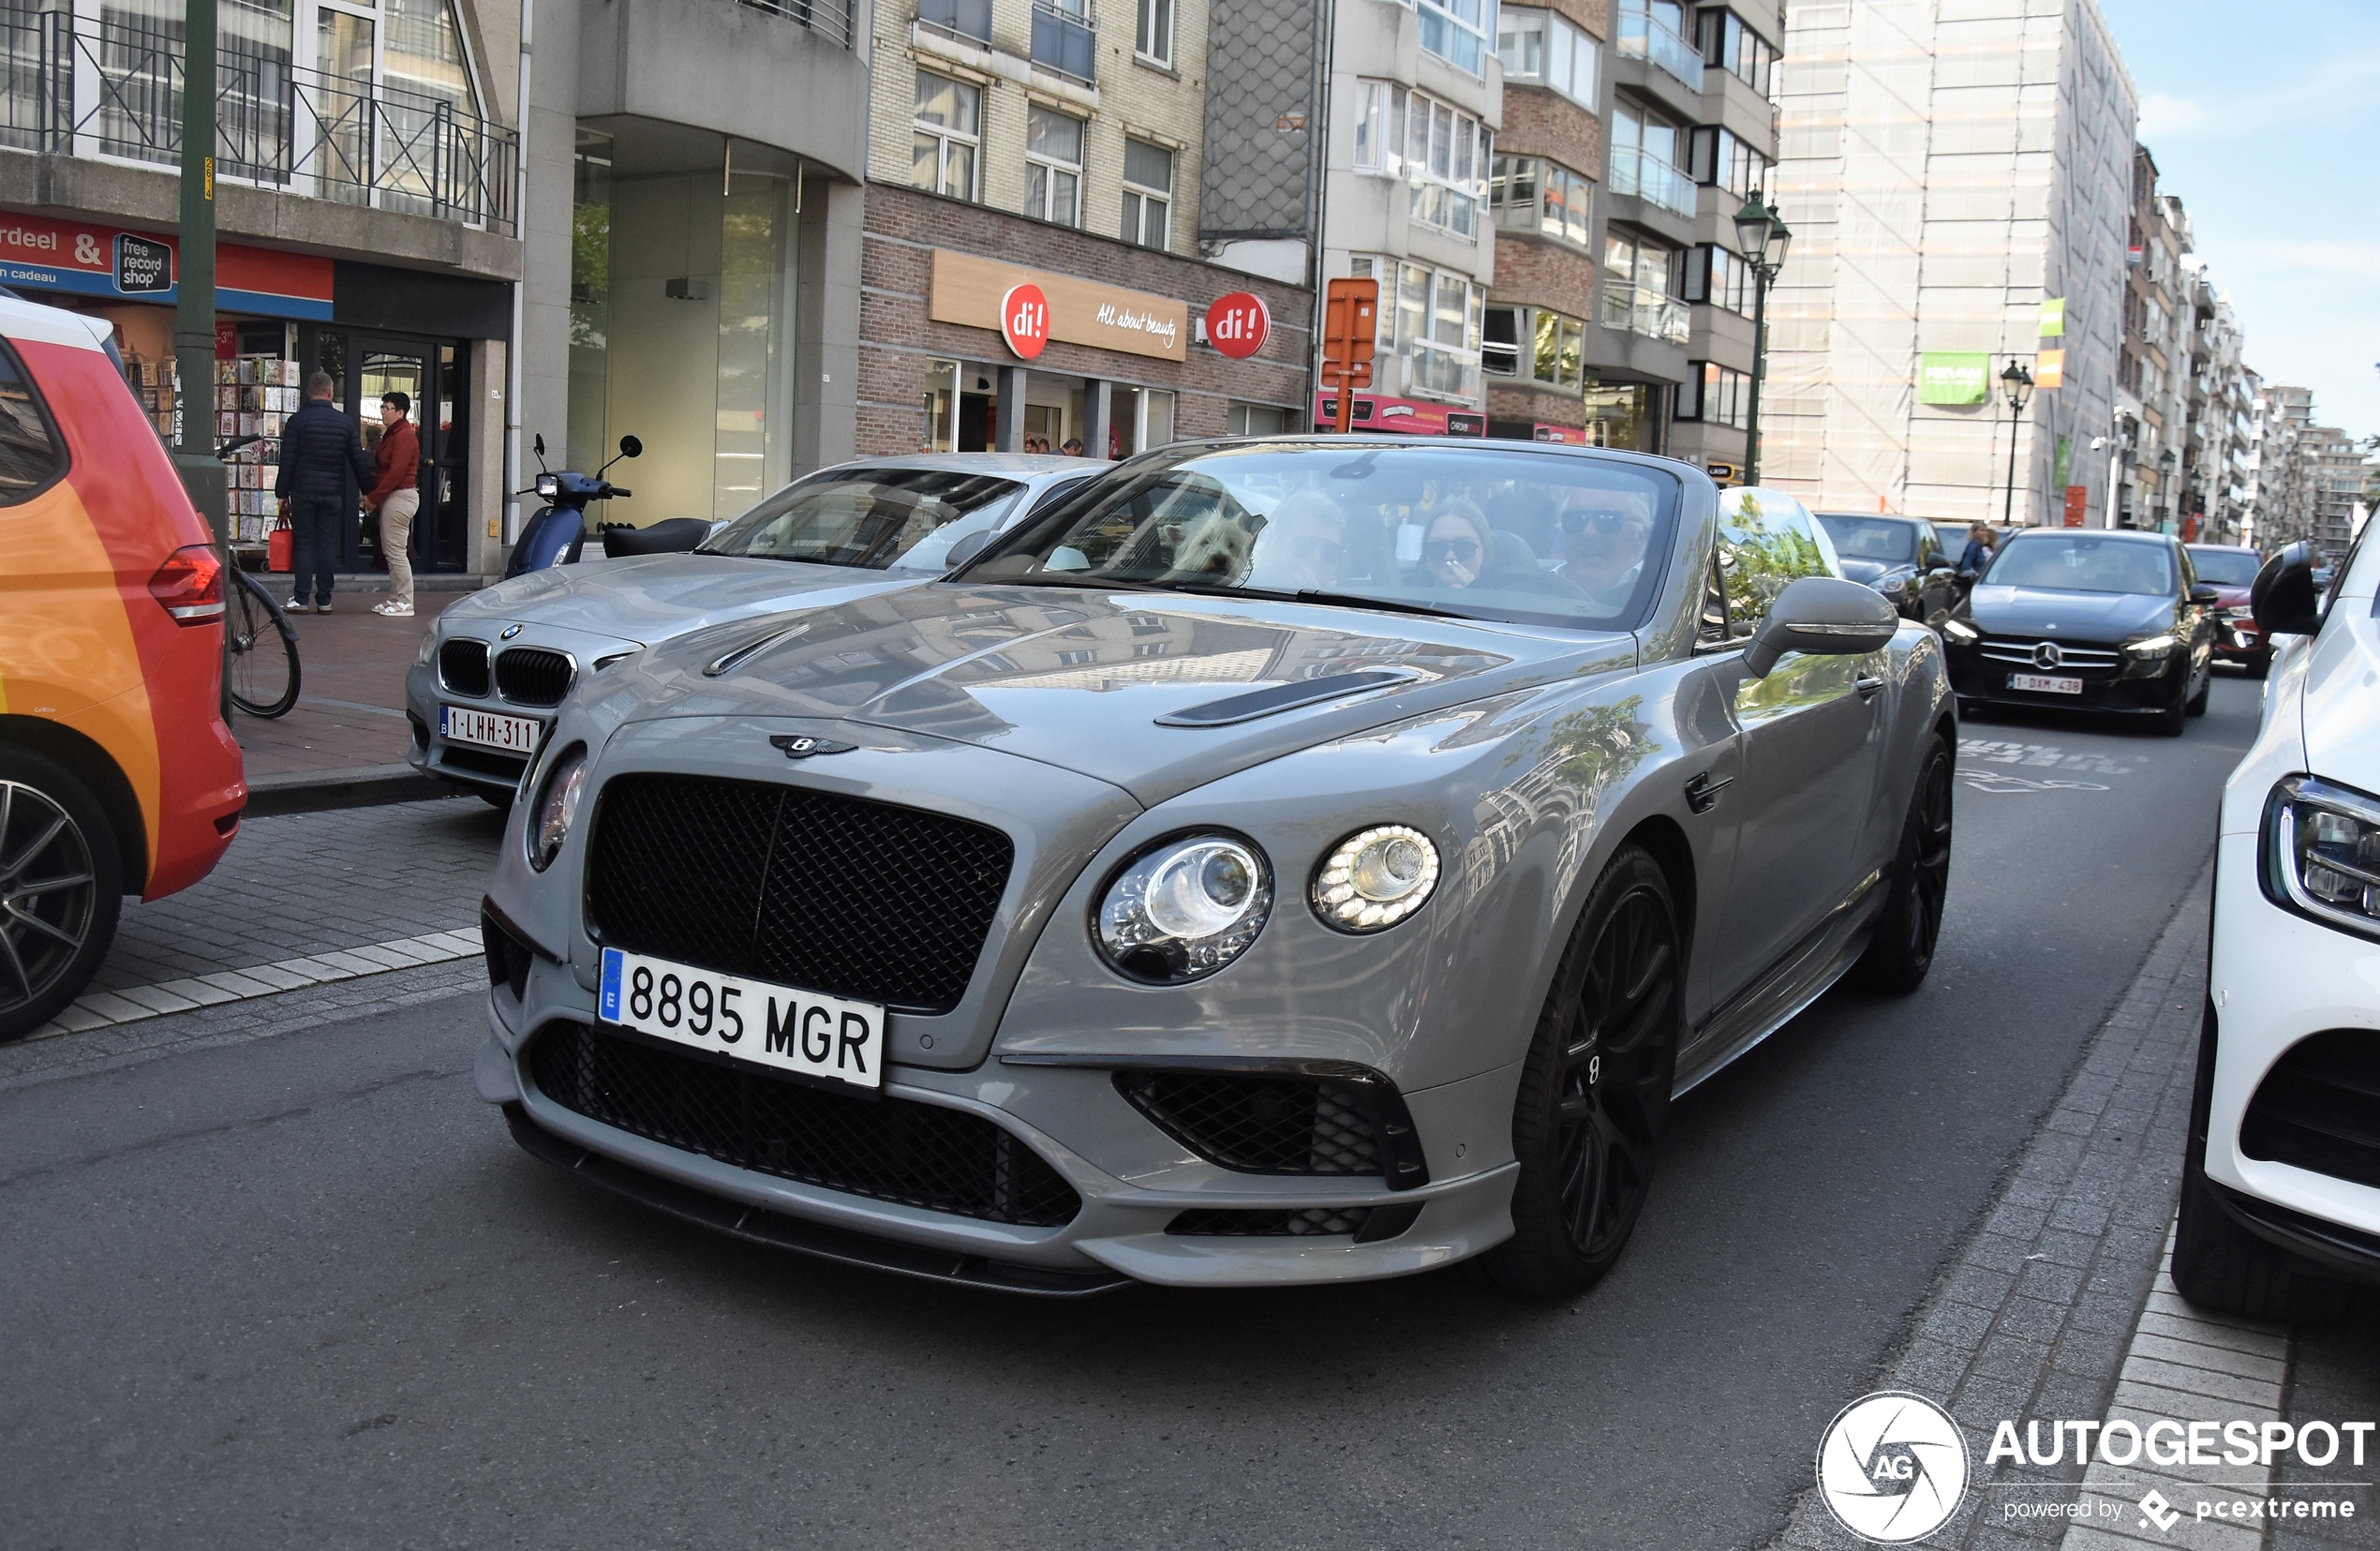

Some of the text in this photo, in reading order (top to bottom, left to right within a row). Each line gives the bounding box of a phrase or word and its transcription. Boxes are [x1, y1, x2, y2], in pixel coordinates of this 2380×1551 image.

[75, 233, 103, 266] &
[124, 238, 149, 257] free
[124, 256, 162, 271] record
[11, 269, 56, 283] cadeau
[124, 269, 155, 288] shop
[1013, 302, 1044, 338] di!
[1096, 303, 1176, 349] All about beauty
[1215, 307, 1257, 340] di!
[2016, 677, 2080, 692] 1-DXM-438
[440, 710, 530, 748] B 1-LHH-311
[606, 965, 870, 1074] E 8895 MGR
